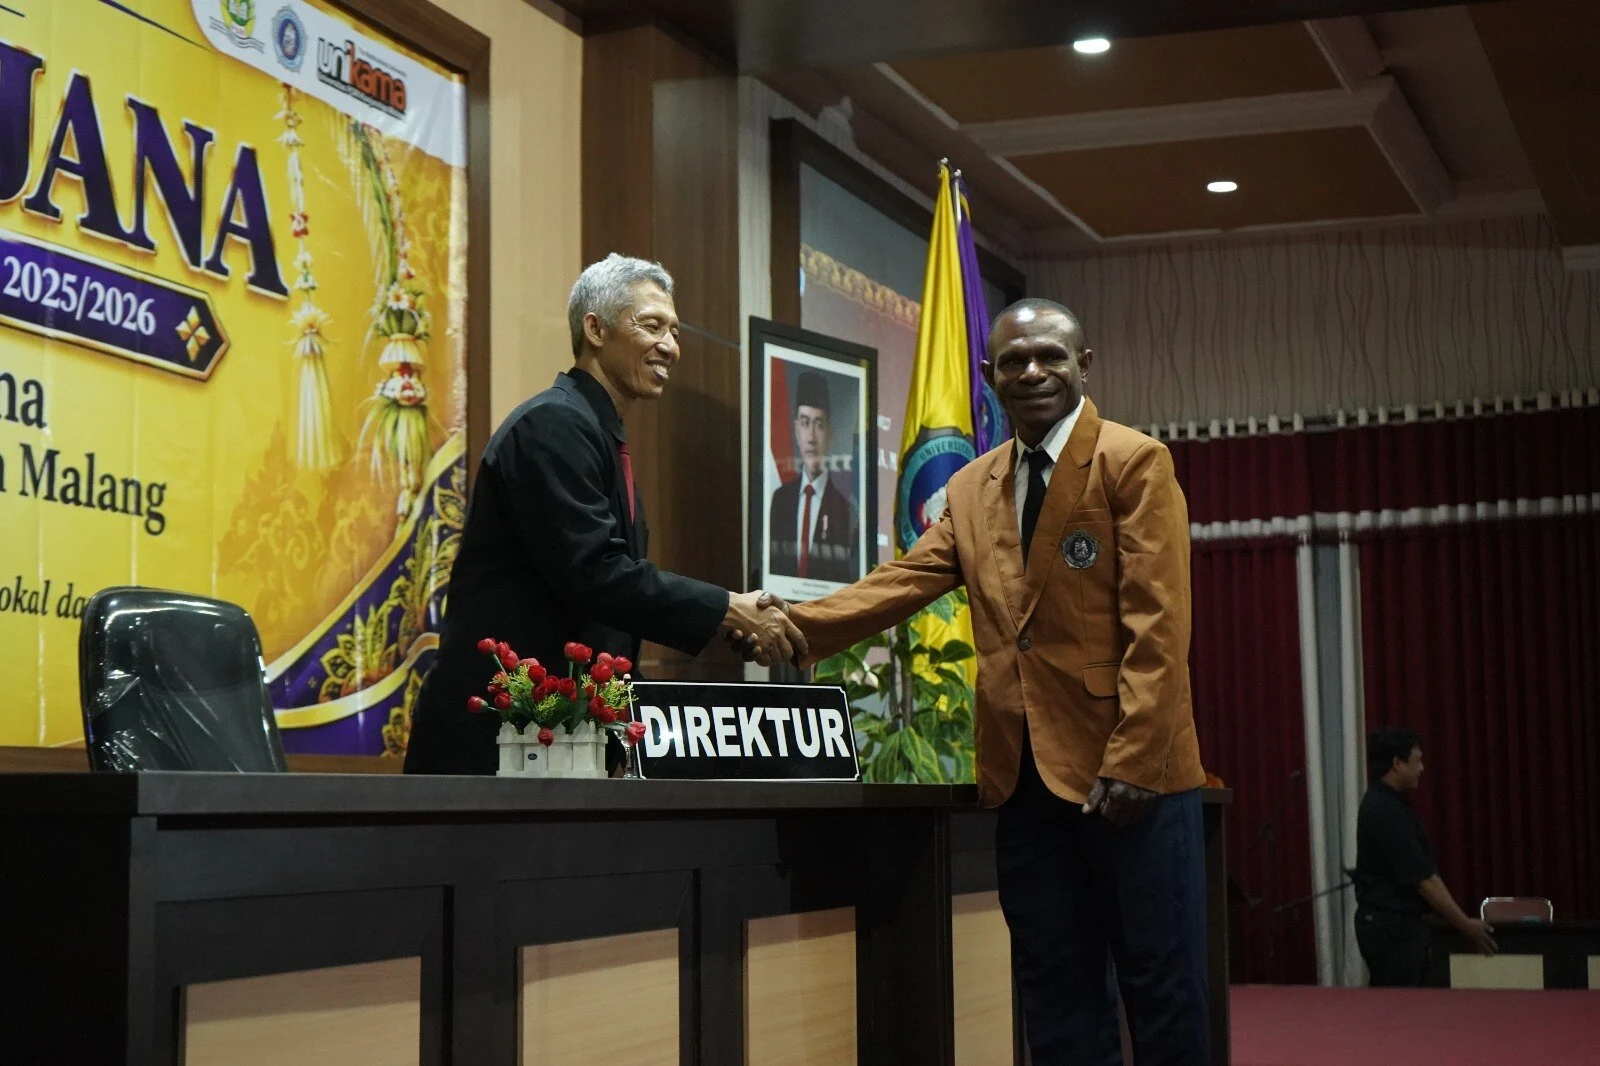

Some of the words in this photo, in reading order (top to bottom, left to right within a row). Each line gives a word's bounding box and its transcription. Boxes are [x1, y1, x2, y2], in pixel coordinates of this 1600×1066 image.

[317, 37, 406, 114] unikama
[3, 256, 156, 335] 2025/2026
[19, 442, 167, 536] Malang
[640, 705, 851, 758] DIREKTUR
